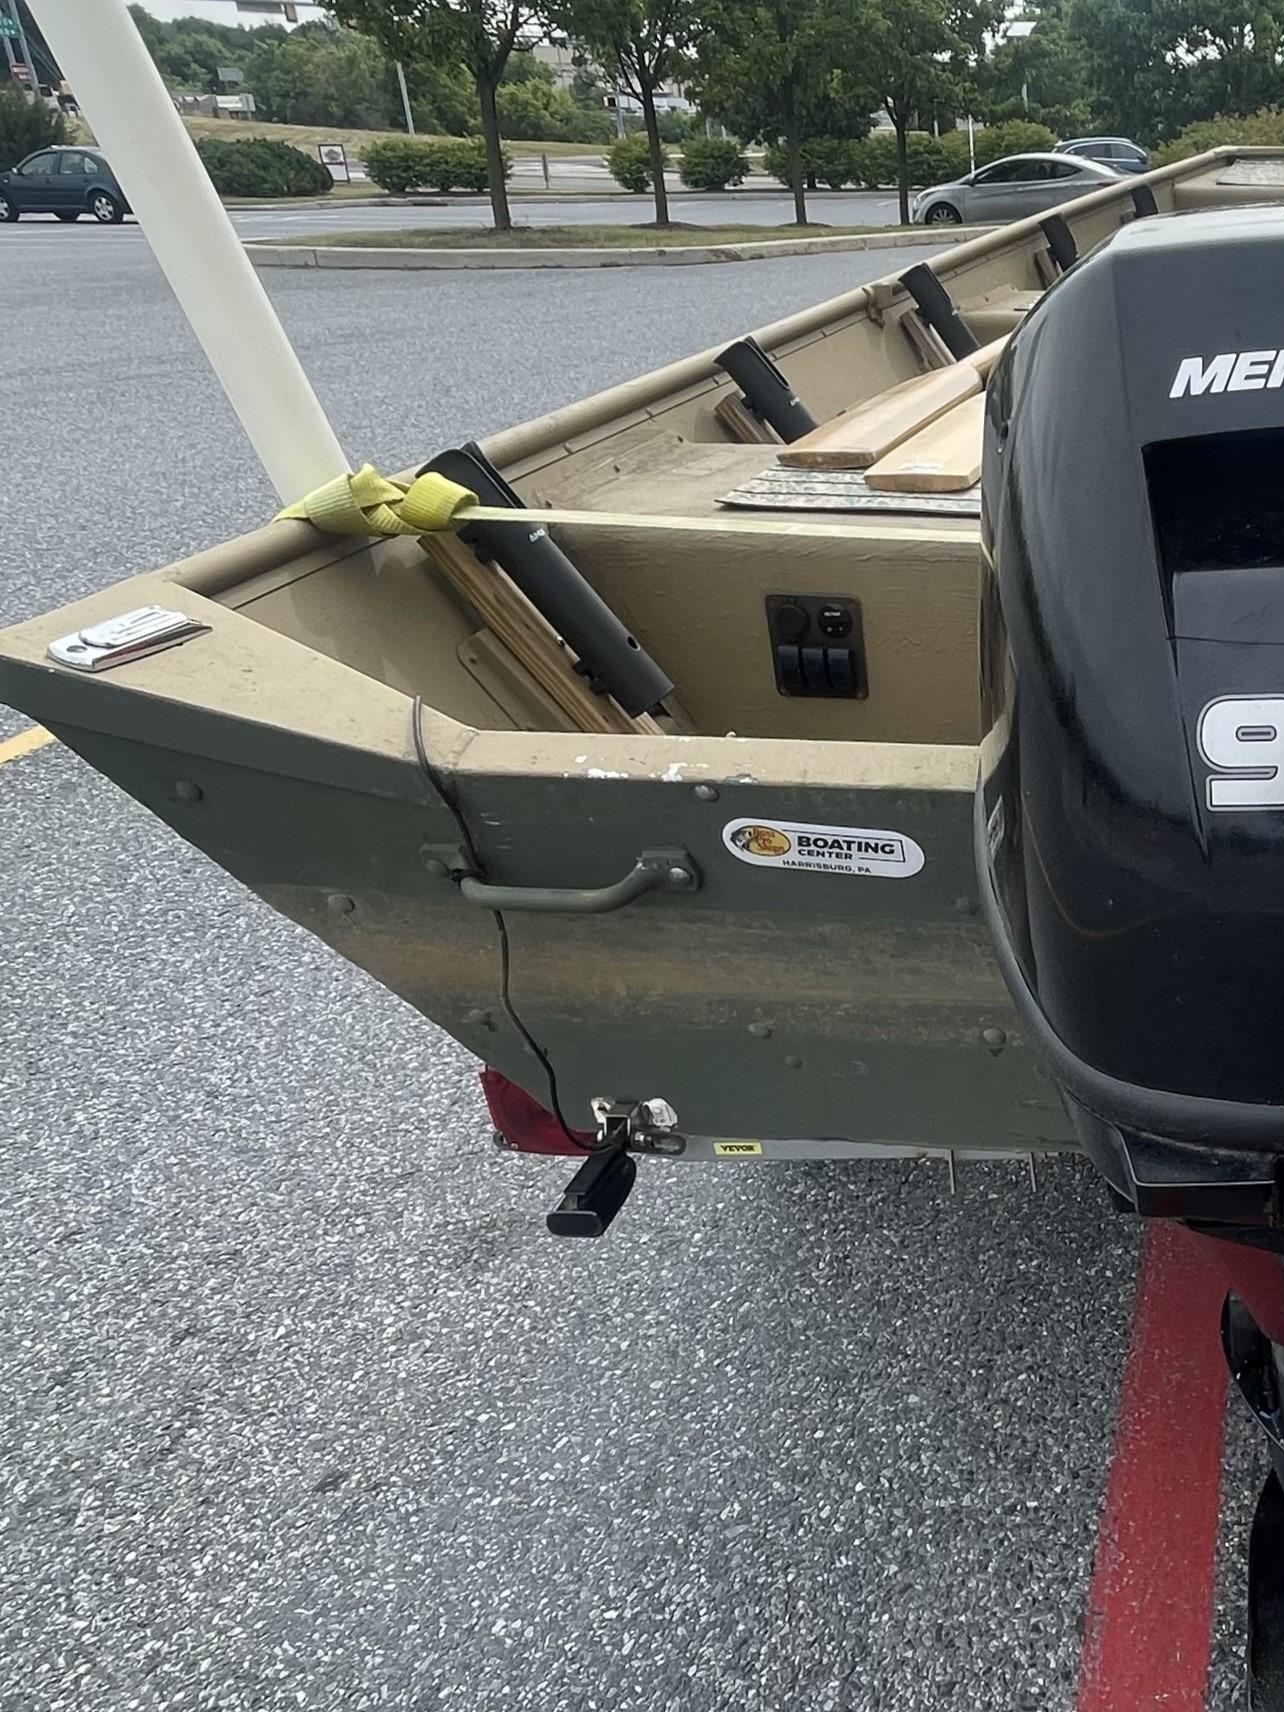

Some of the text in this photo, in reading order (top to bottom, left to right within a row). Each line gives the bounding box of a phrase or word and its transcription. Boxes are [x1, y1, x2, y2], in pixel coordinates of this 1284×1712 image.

[797, 835, 896, 855] BOATING
[798, 848, 853, 861] CENTER
[782, 859, 872, 874] HARRISBURG, PA
[720, 1144, 755, 1152] VEVOR
